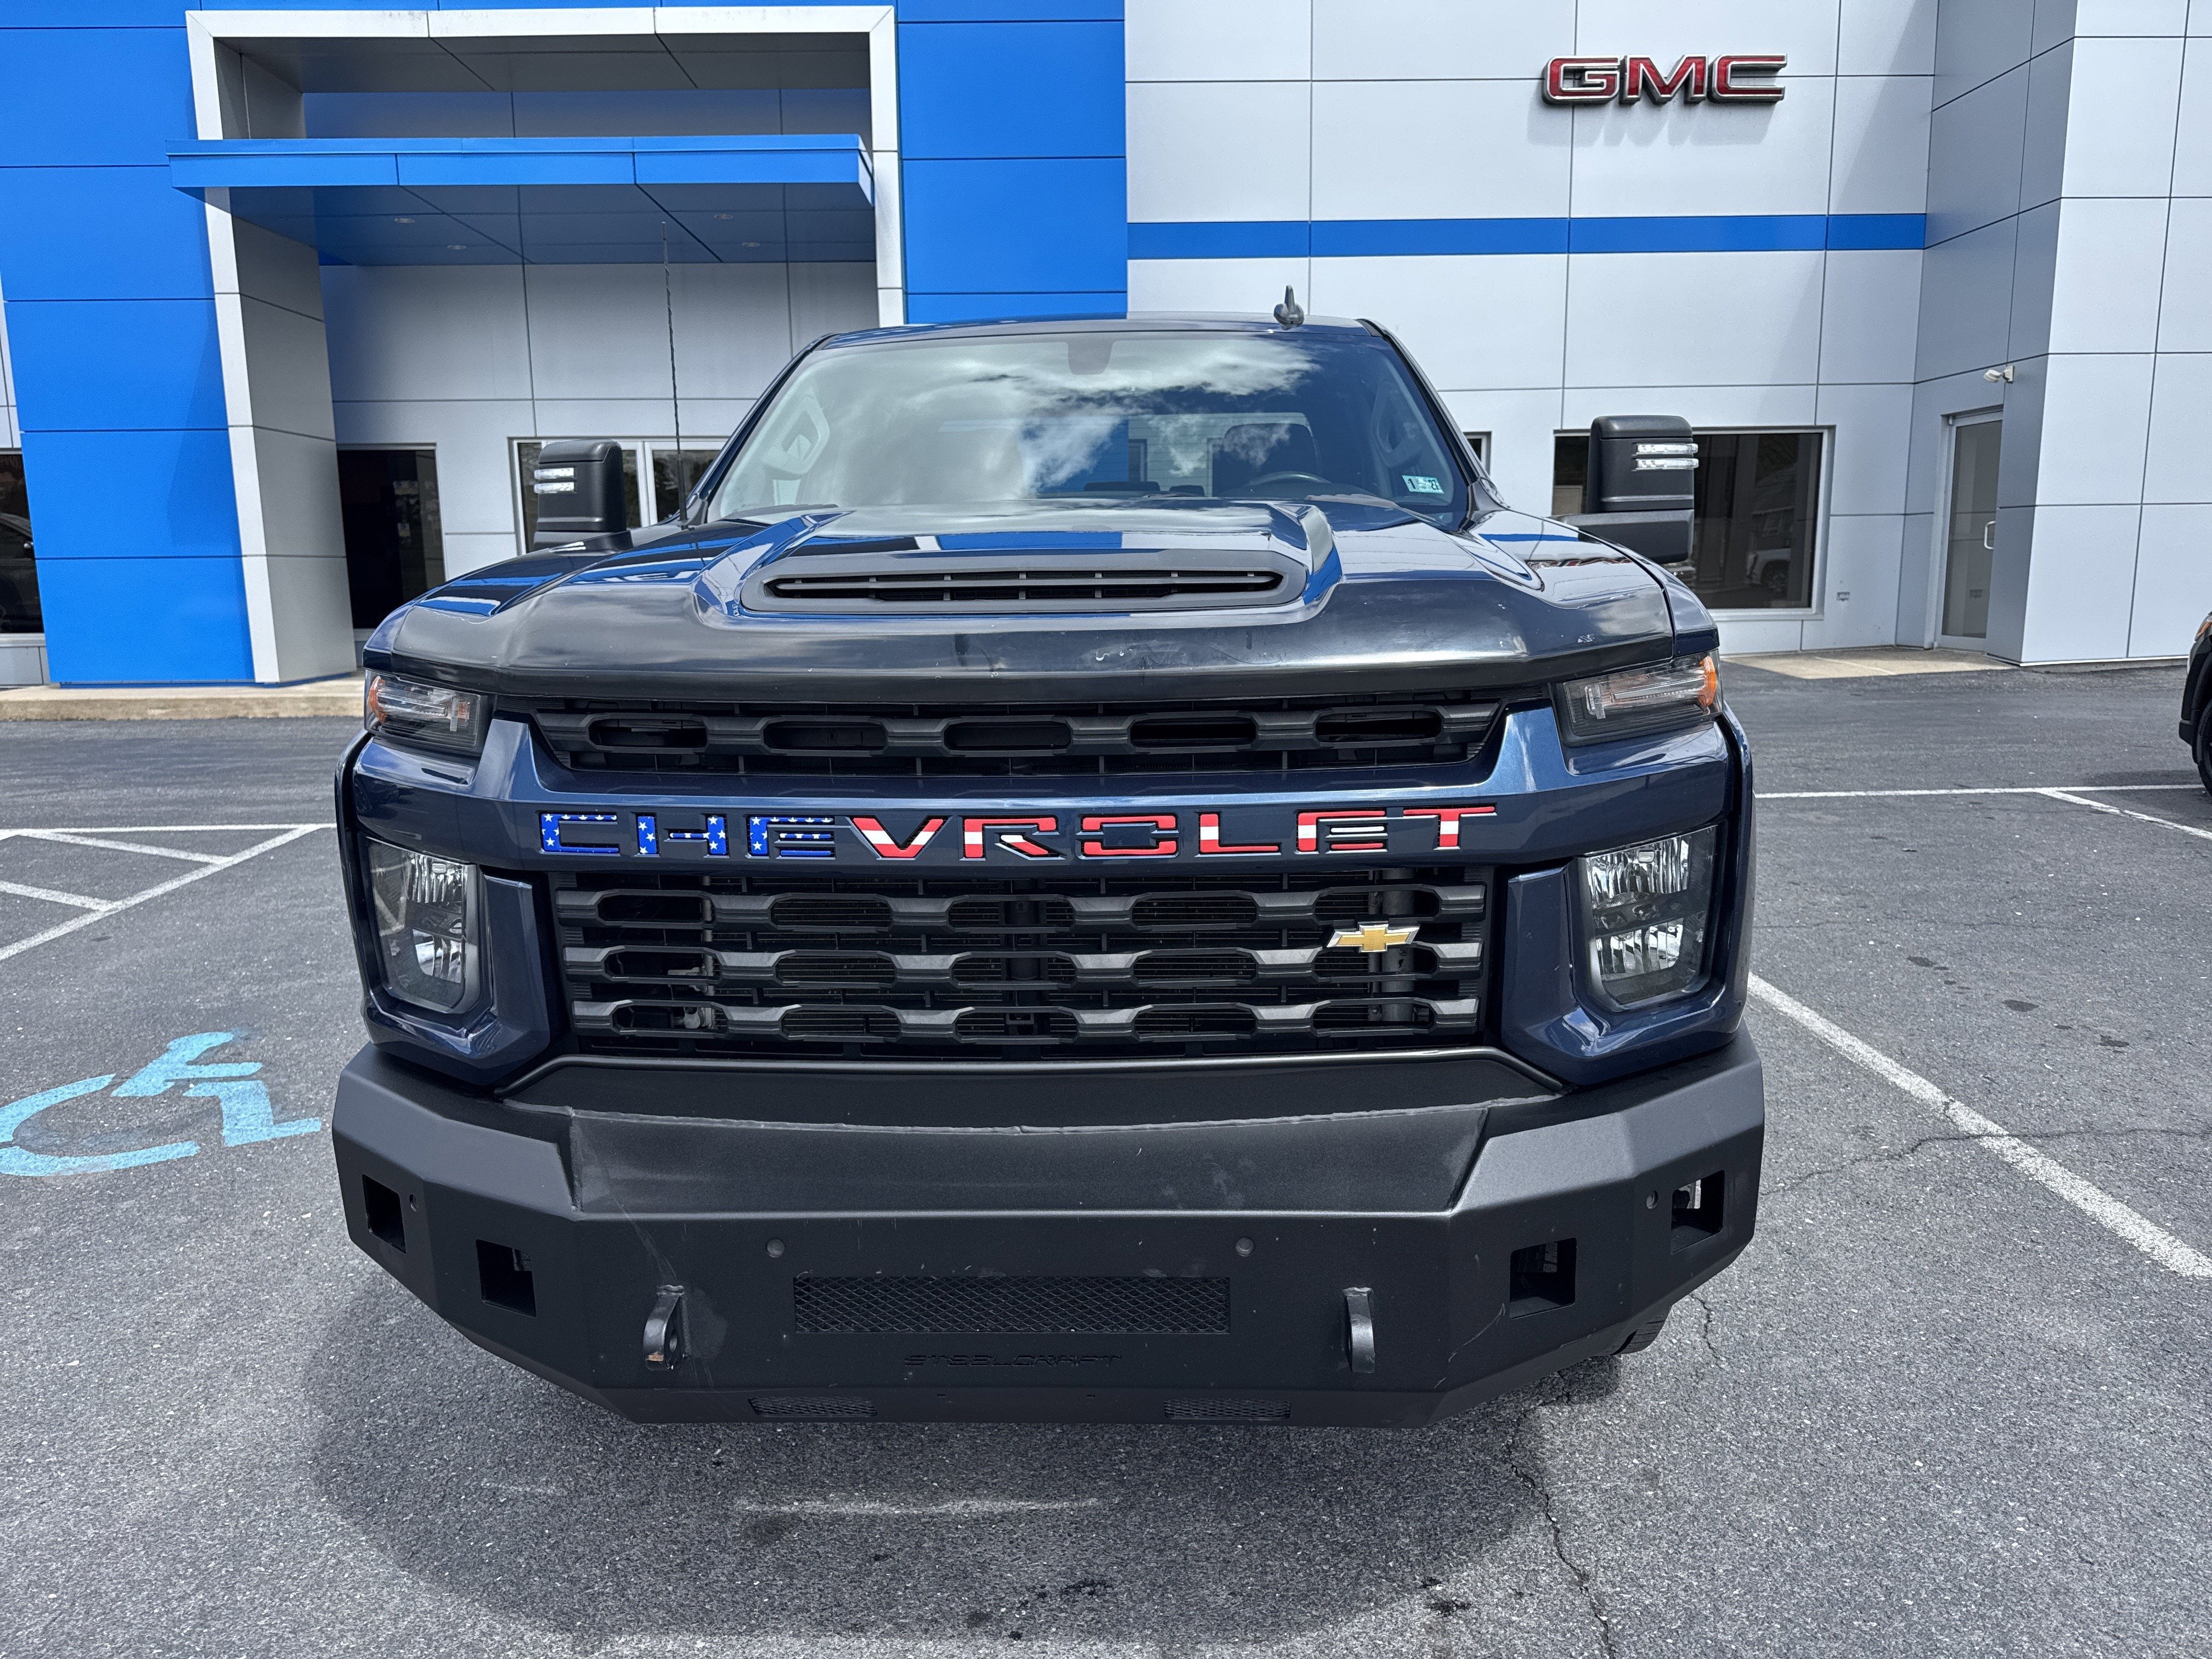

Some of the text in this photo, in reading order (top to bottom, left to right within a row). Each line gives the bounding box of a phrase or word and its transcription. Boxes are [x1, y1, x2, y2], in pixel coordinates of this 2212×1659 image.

[1544, 53, 1787, 103] GMC
[539, 804, 1497, 860] CHEVROLET
[905, 1355, 1121, 1366] STEELCRAFT
